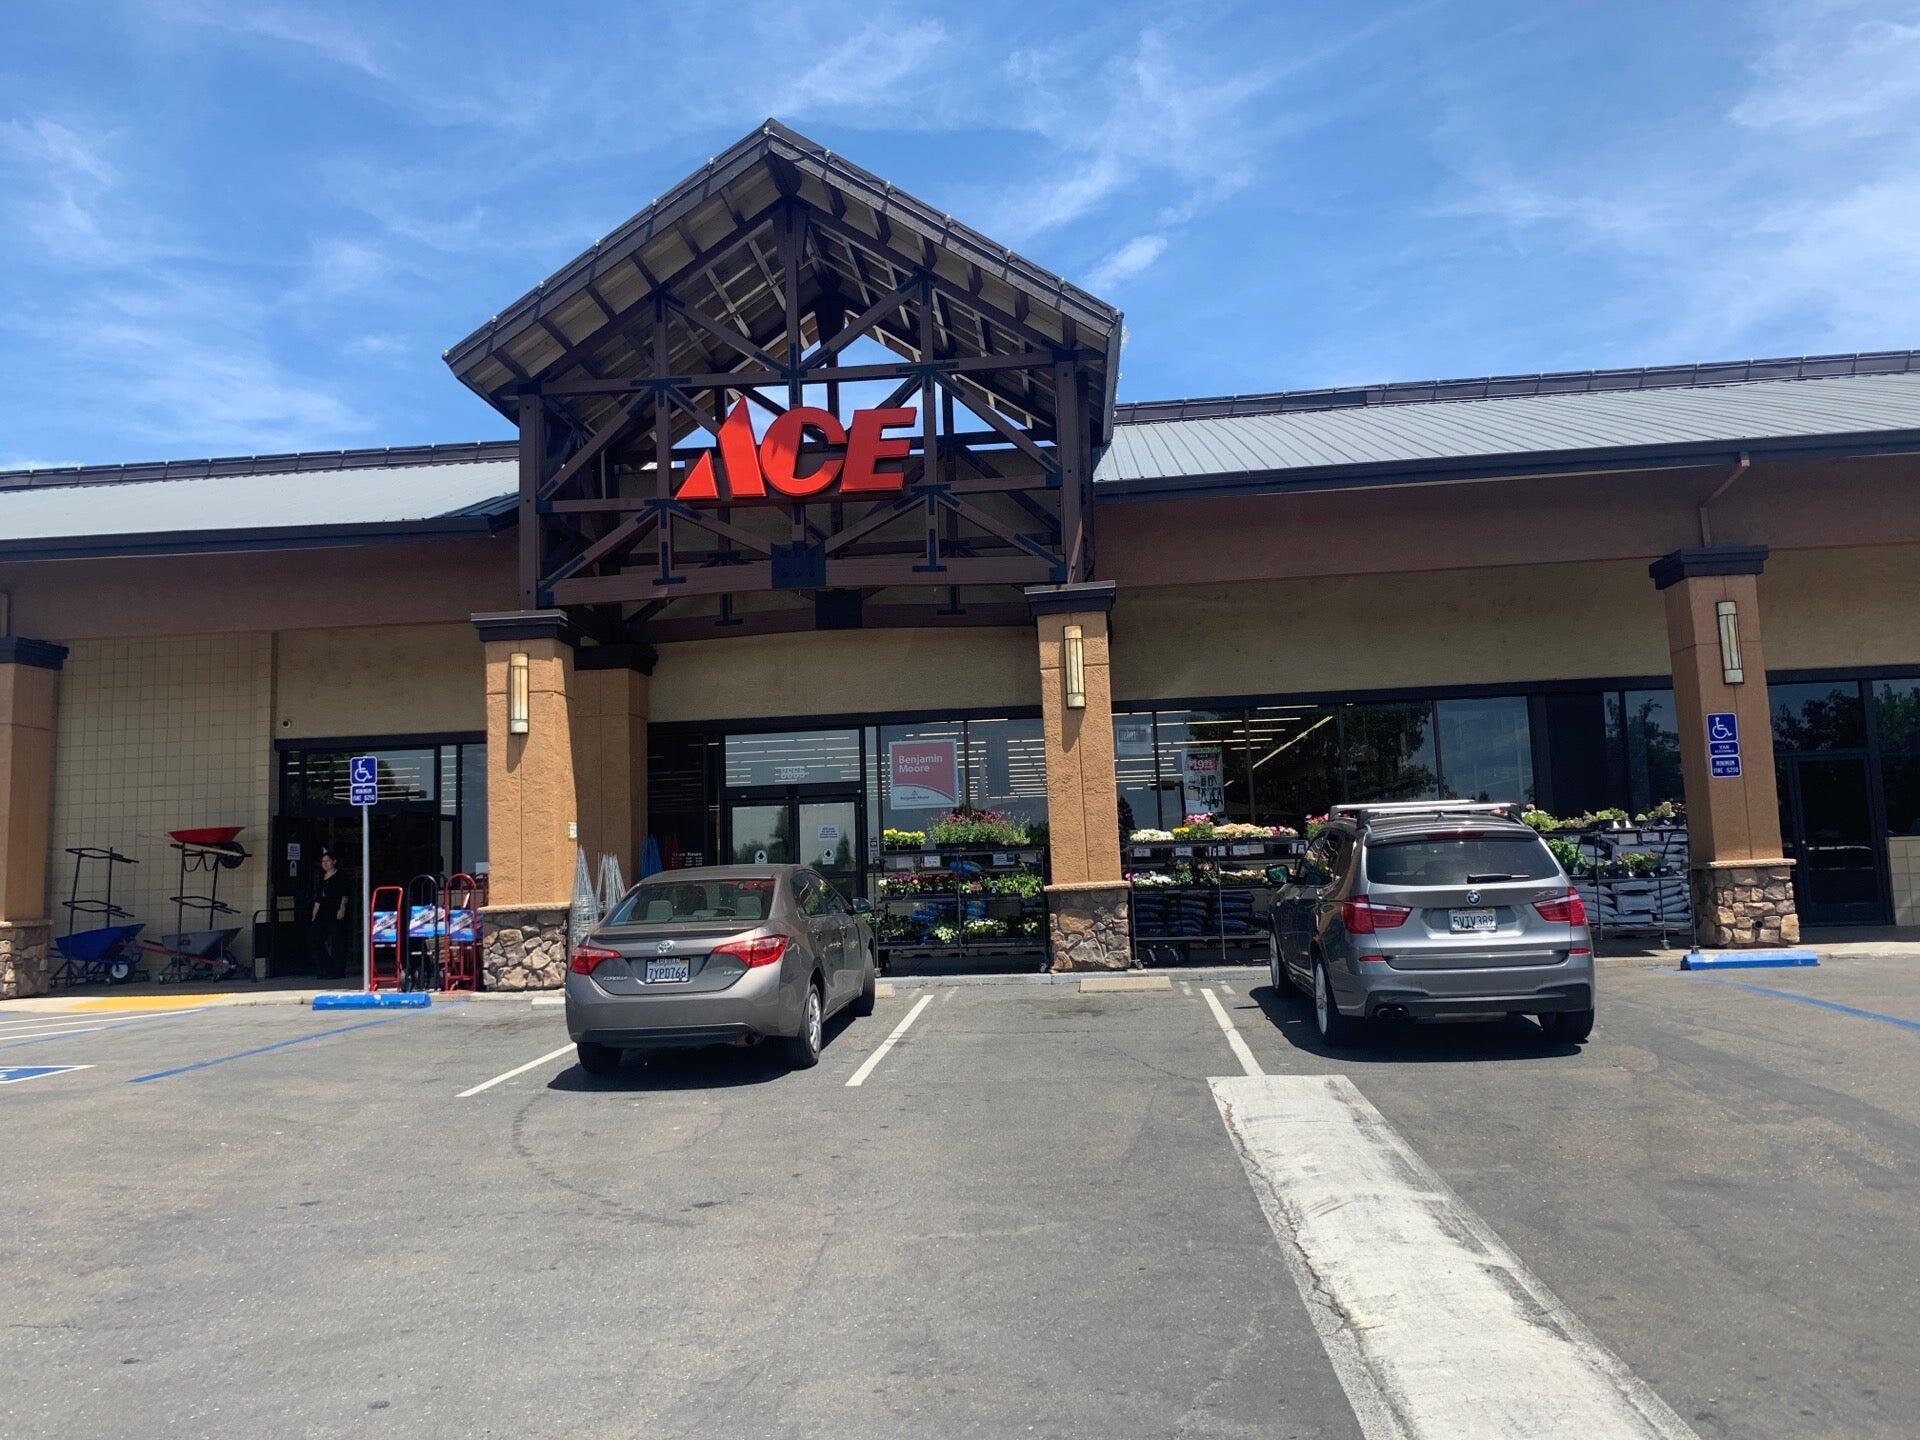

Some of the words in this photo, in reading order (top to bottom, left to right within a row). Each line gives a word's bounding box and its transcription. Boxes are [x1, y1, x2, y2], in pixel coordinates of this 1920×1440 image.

[673, 394, 917, 499] ACE
[898, 754, 943, 765] Benjamin
[899, 765, 930, 773] Moore
[649, 966, 687, 979] 7YPD766
